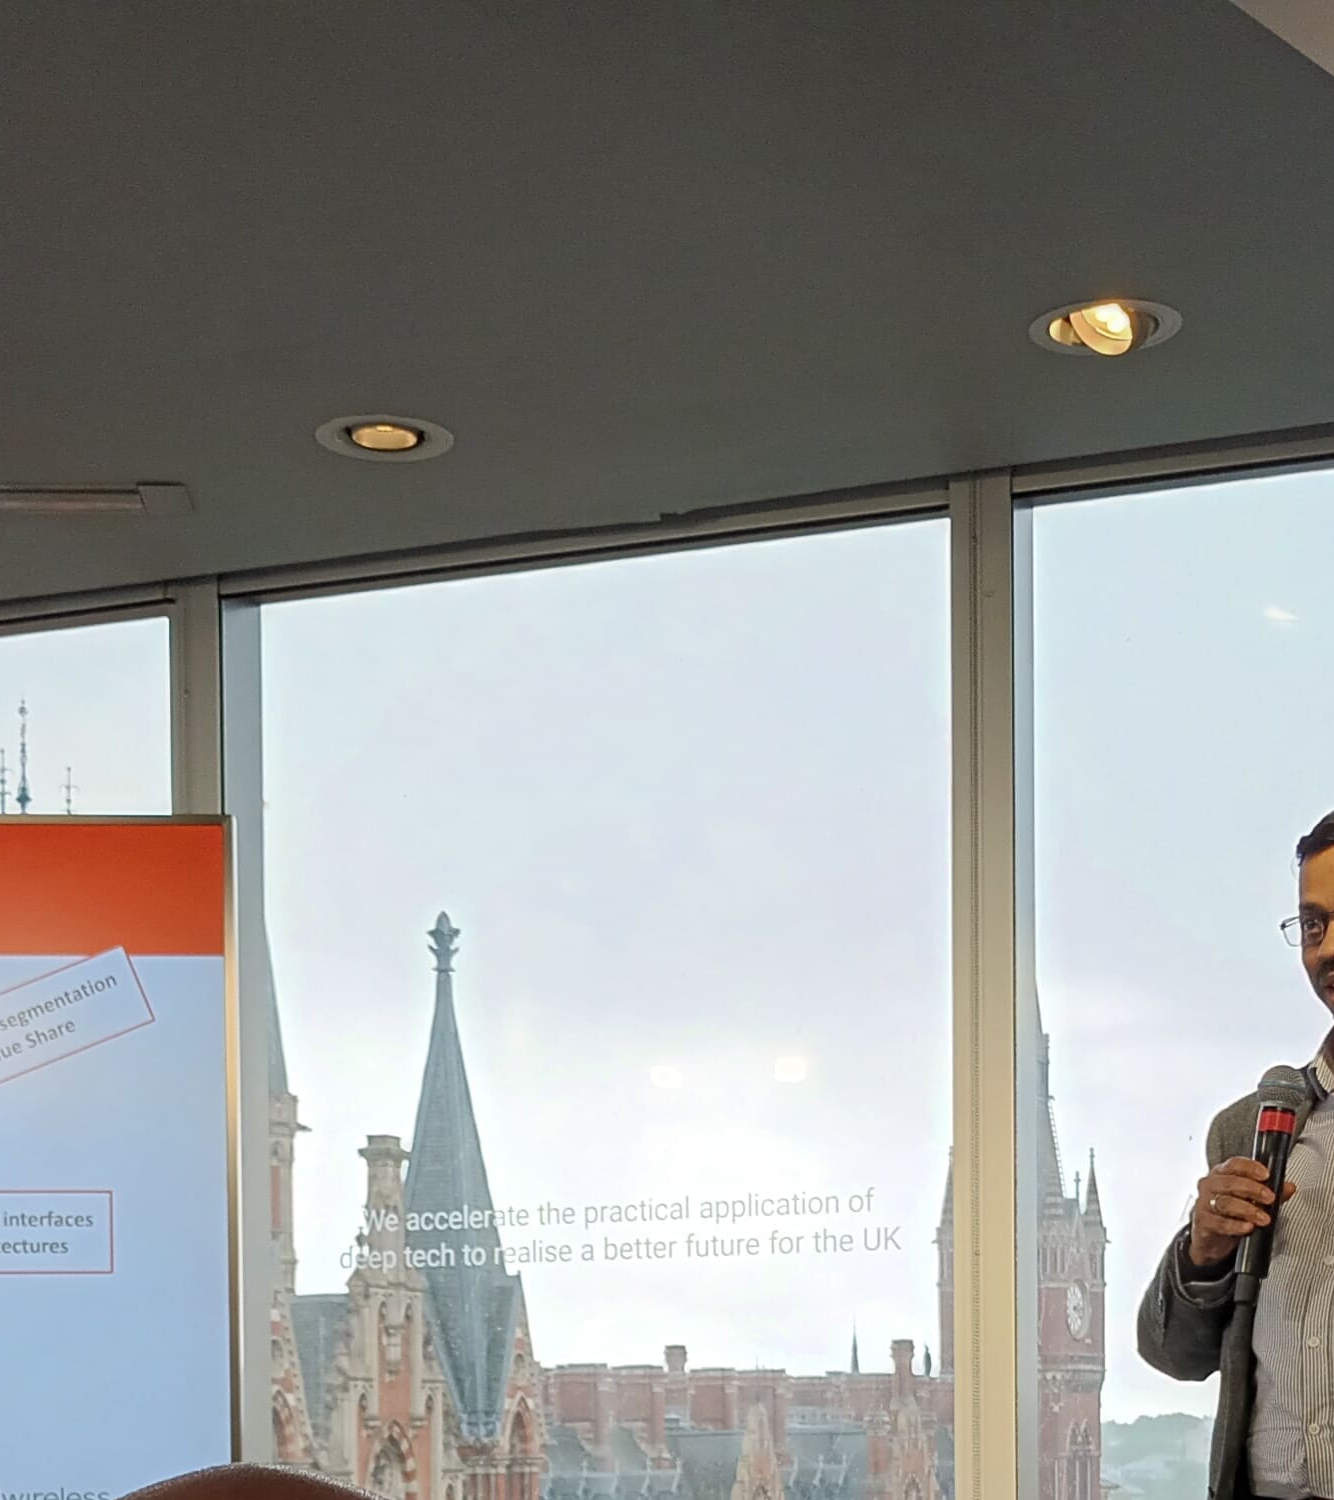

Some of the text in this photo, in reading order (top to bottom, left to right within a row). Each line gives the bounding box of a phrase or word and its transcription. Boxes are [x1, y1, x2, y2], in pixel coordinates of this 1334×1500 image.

[24, 1017, 77, 1050] Share
[3, 1209, 94, 1229] interfaces
[364, 1187, 876, 1234] We accelerate the practical application of
[340, 1225, 903, 1276] deep tech to realise a better future for the UK
